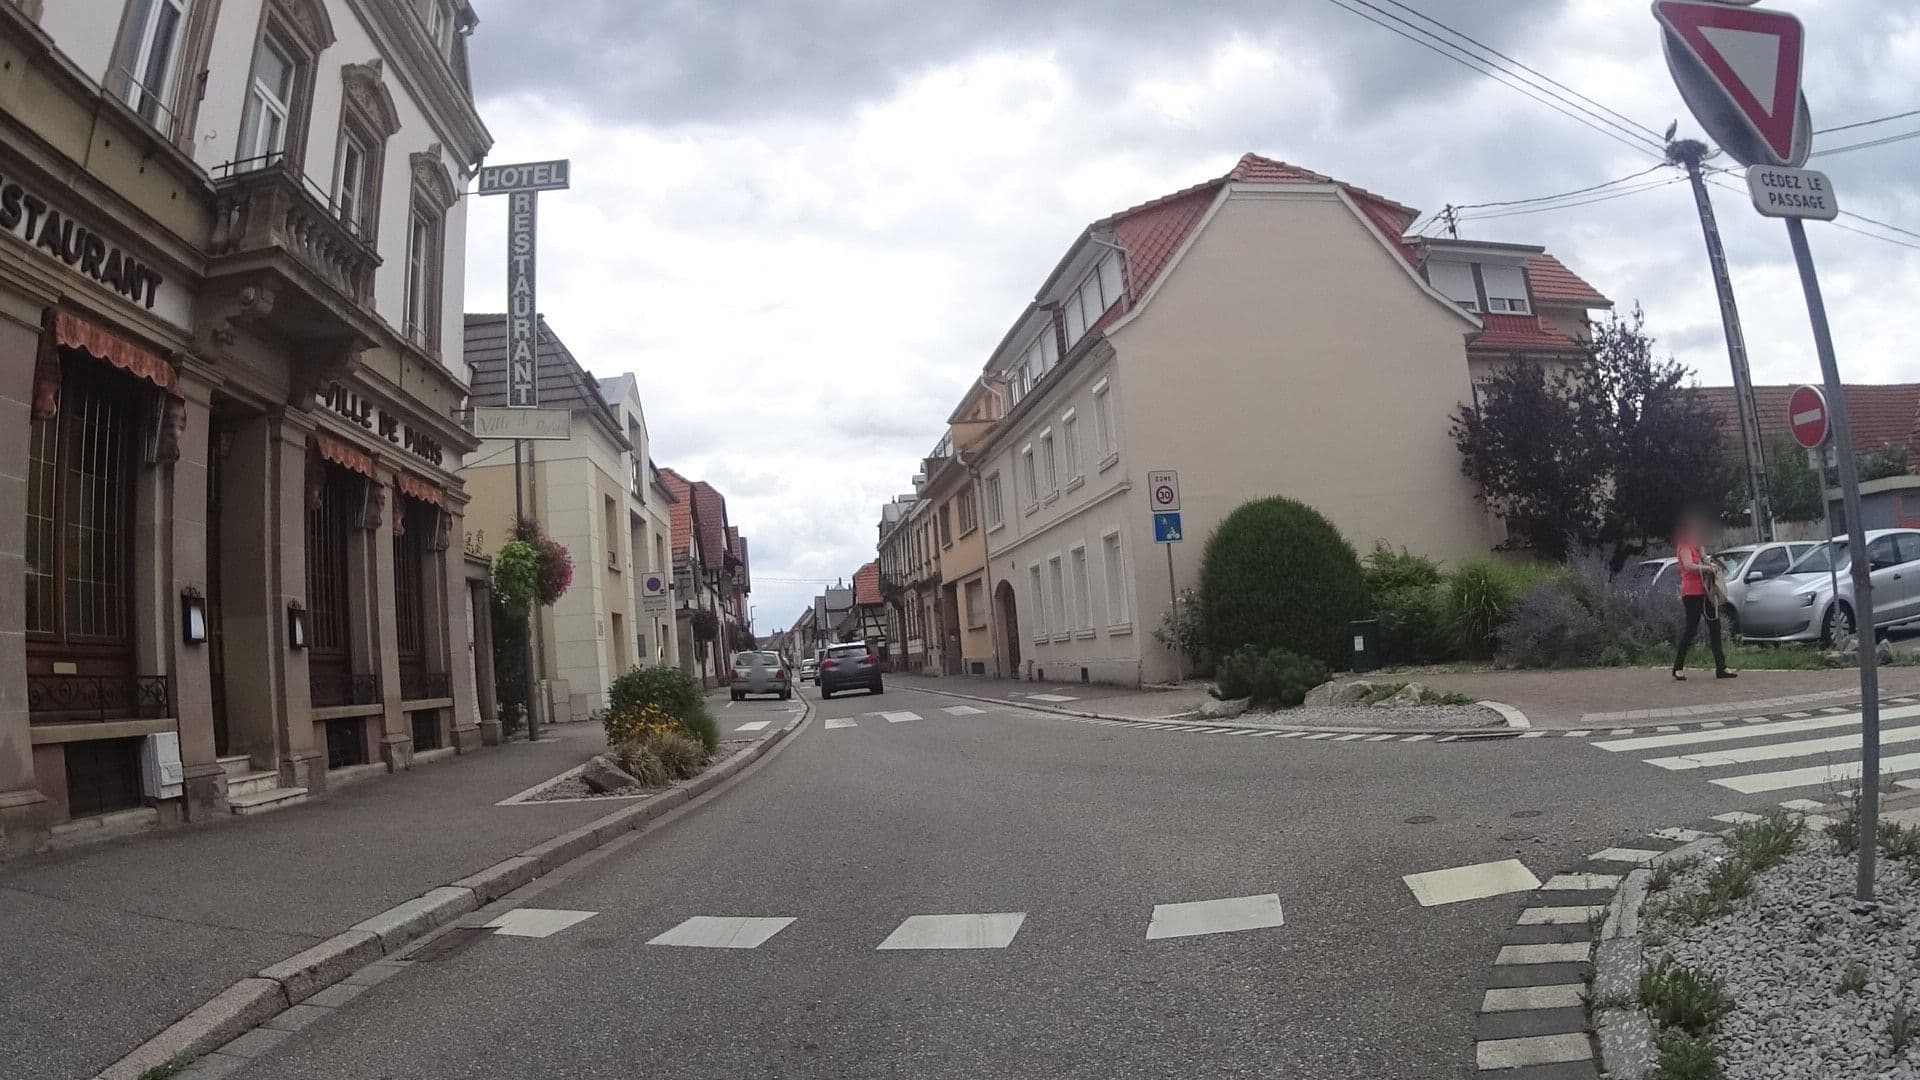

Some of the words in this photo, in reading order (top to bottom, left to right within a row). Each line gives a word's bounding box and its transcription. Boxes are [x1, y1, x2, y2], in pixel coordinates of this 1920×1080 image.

[483, 164, 565, 188] HOTEL
[1761, 171, 1802, 189] CÉDEZ
[1807, 178, 1823, 191] LE
[1769, 192, 1825, 210] PASSAGE
[0, 174, 163, 309] STAURANT
[514, 193, 531, 404] RESTAURANT
[317, 382, 372, 428] VILLE
[1160, 491, 1170, 500] 30
